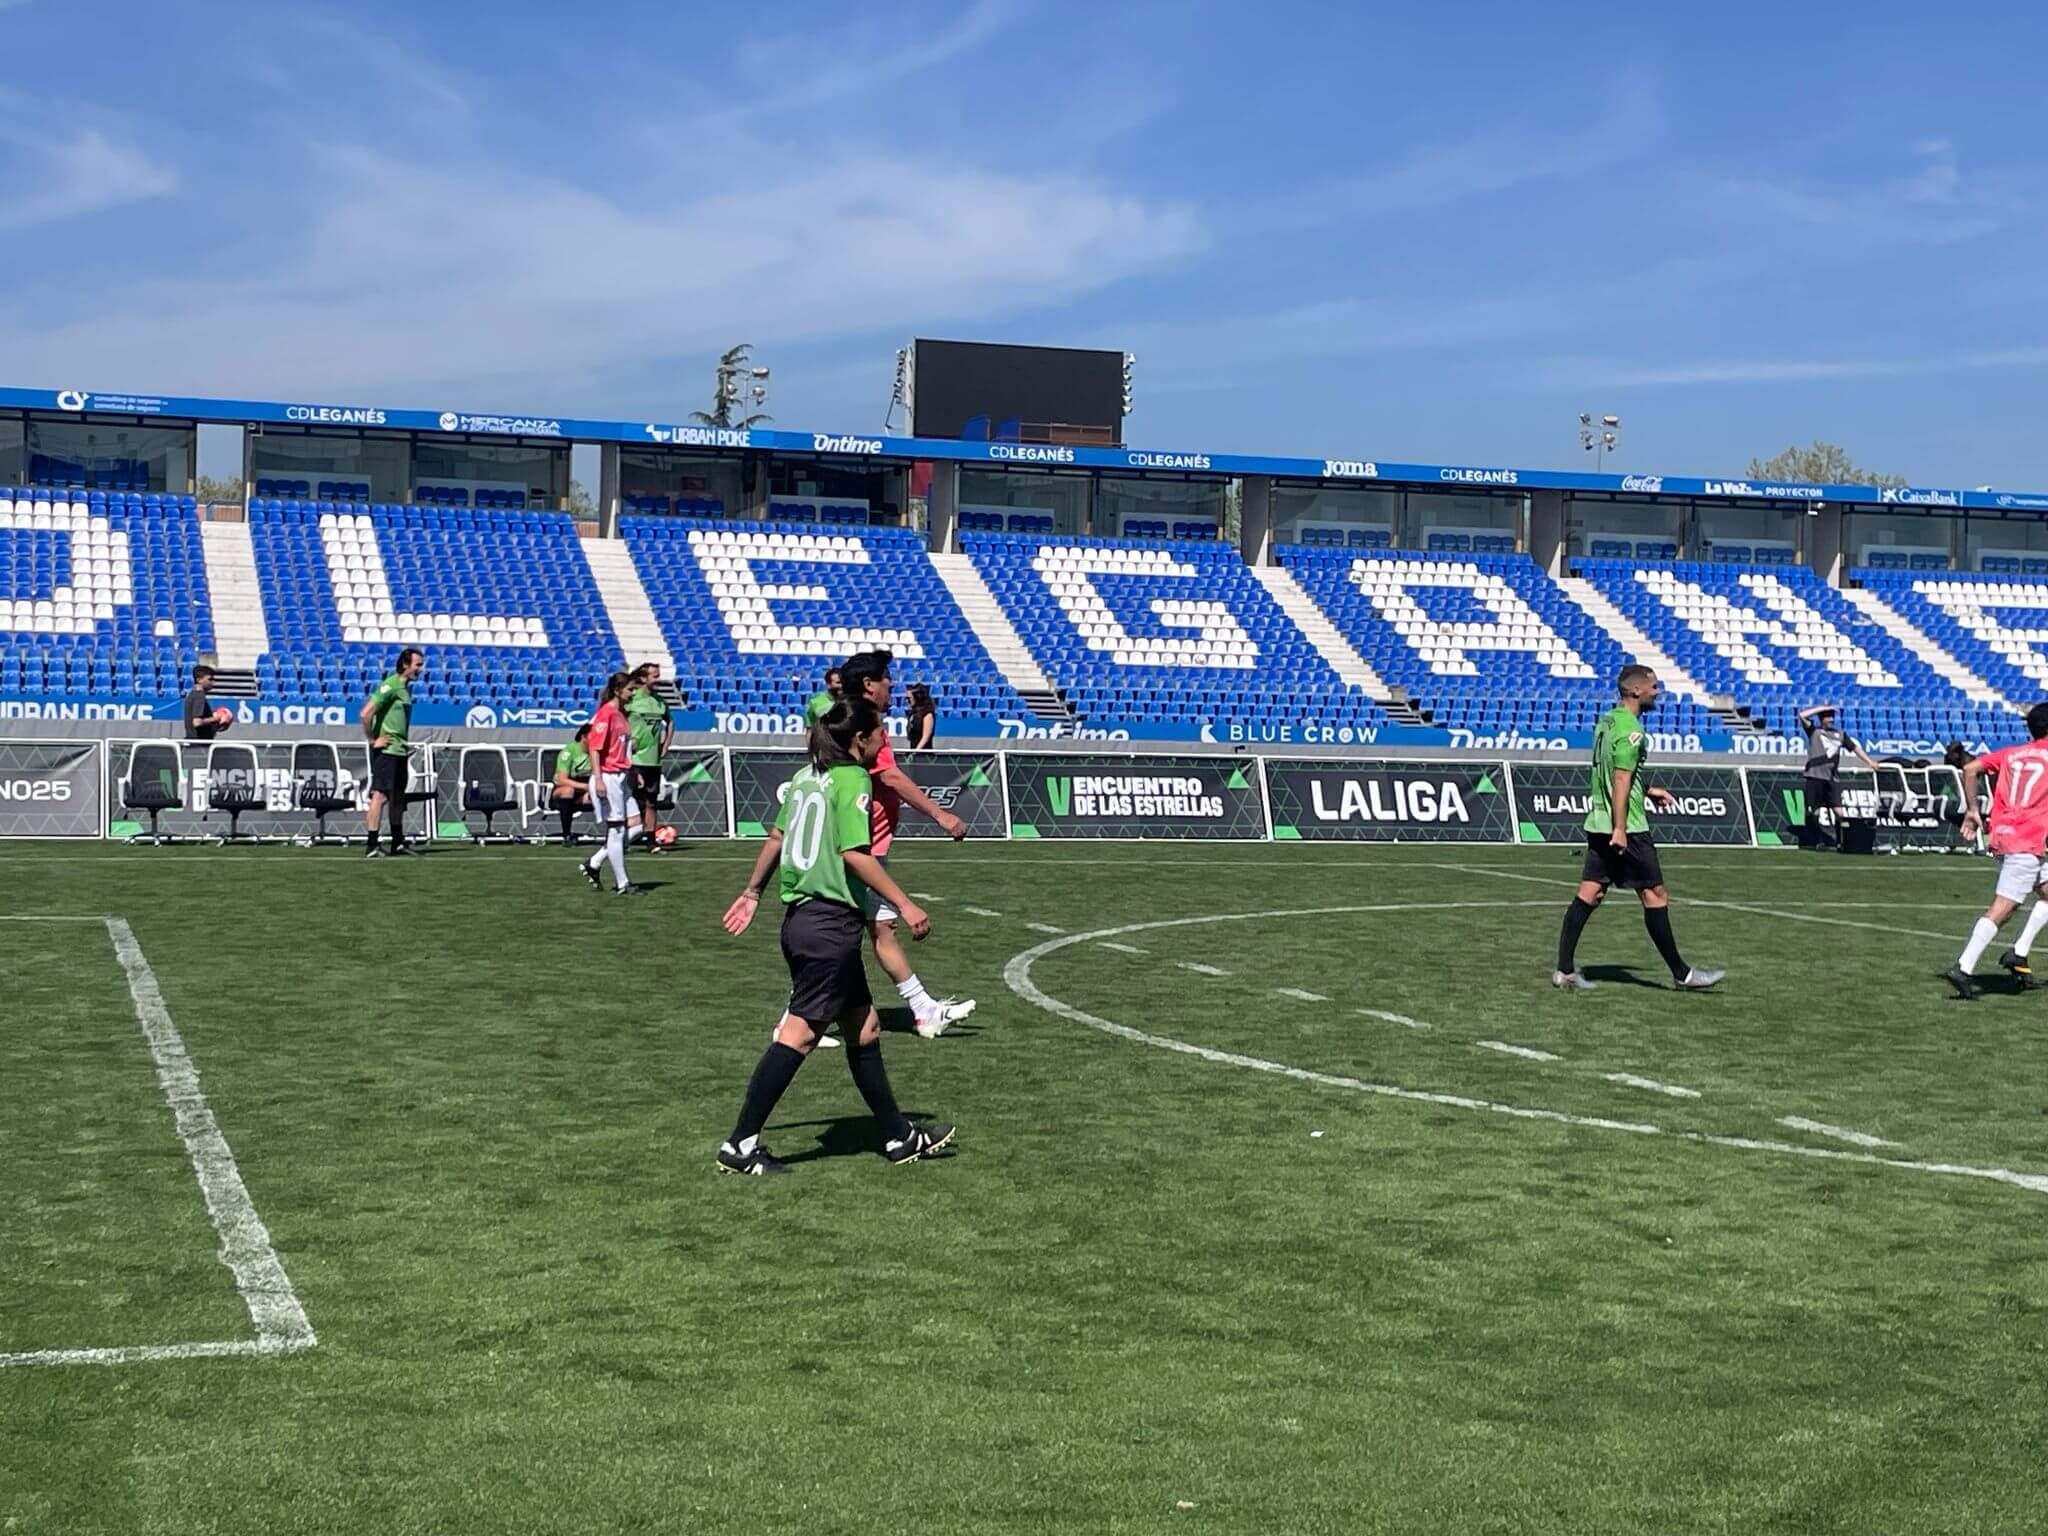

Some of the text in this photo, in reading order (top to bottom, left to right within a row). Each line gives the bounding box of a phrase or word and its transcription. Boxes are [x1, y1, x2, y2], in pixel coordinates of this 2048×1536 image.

[672, 427, 750, 447] URBAN POKE
[813, 433, 883, 454] Ontime
[1900, 489, 1958, 505] CaixaBank
[260, 705, 345, 725] nara
[503, 709, 597, 725] MERC
[998, 719, 1130, 741] Ontime
[1230, 725, 1378, 743] BLUE CROW
[1448, 728, 1568, 750] Ontime
[1865, 740, 1992, 755] MERCAZA
[1073, 776, 1202, 796] ENCUENTRO
[2009, 761, 2044, 807] 17
[1075, 796, 1224, 817] DE LAS ESTRELLAS
[1310, 780, 1470, 822] LALIGA
